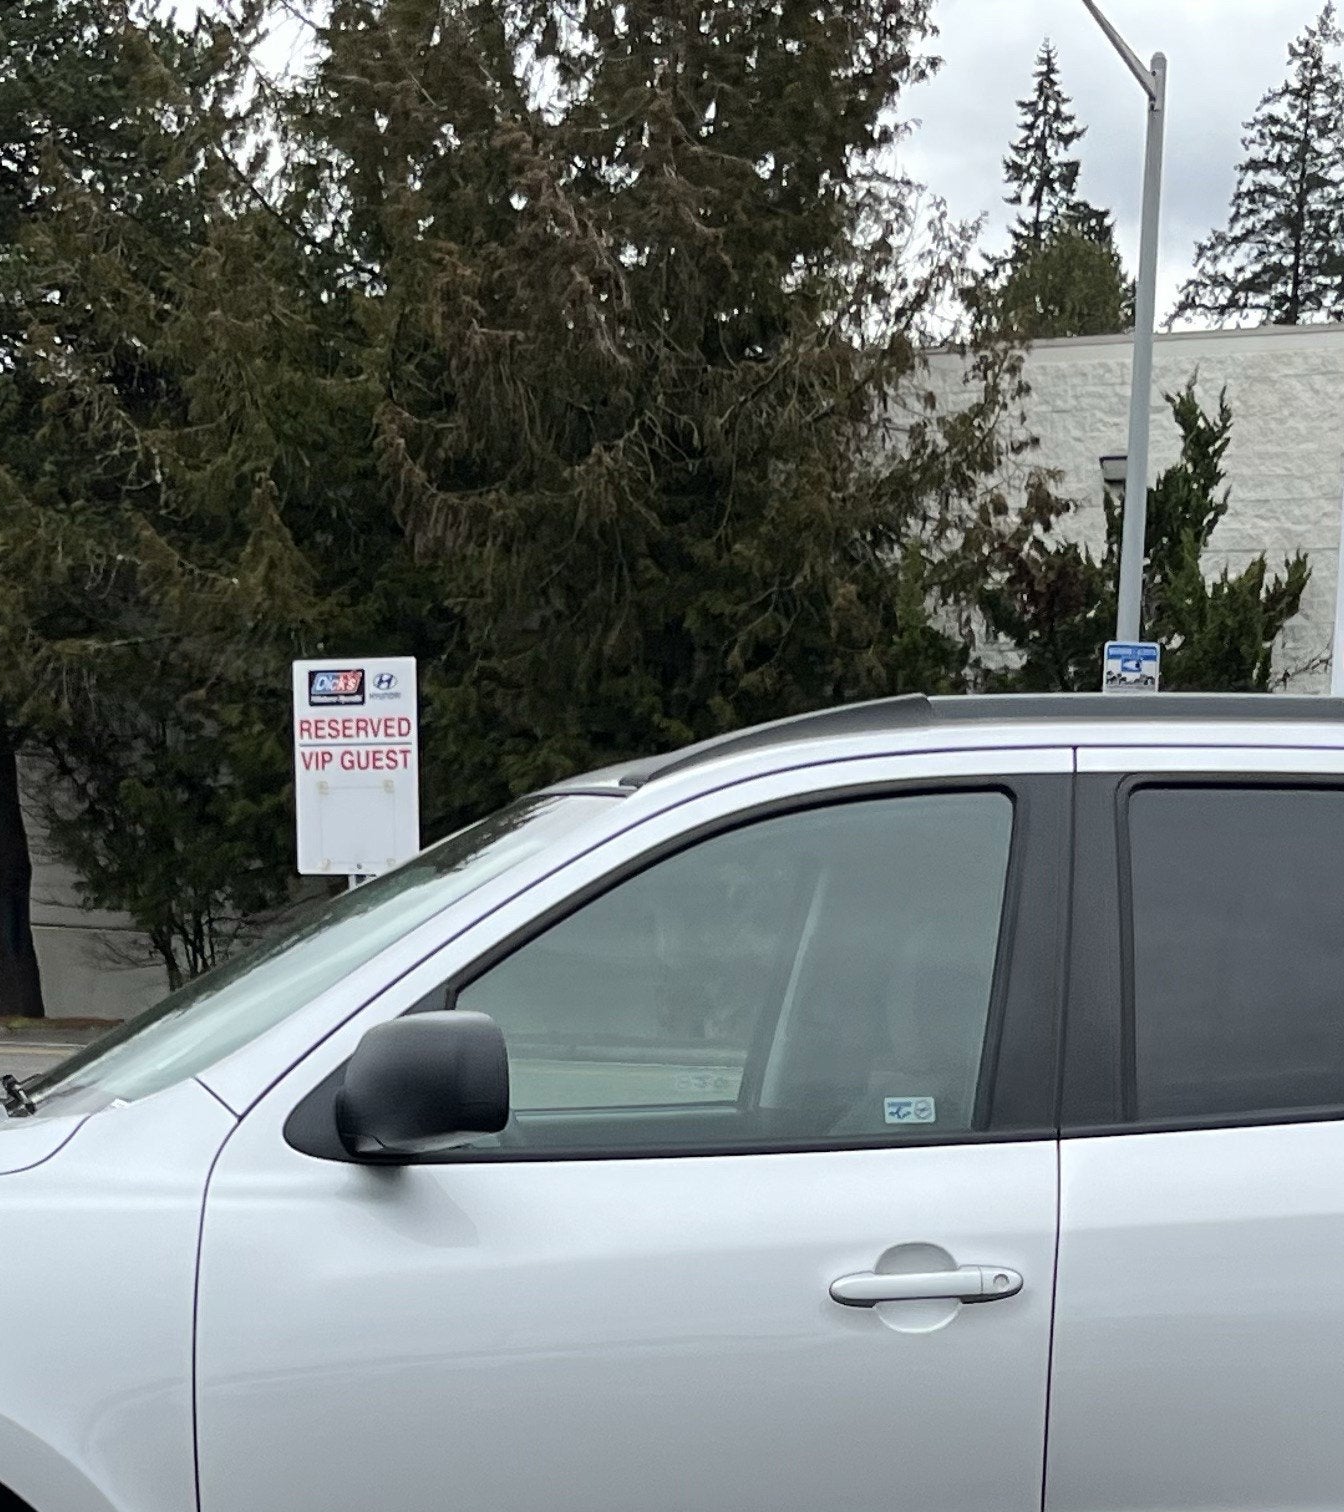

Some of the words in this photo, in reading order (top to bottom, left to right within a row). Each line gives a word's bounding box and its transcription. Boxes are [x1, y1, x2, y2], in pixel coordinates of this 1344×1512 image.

[299, 717, 412, 740] RESERVED
[301, 750, 333, 771] VIP
[340, 749, 412, 771] GUEST
